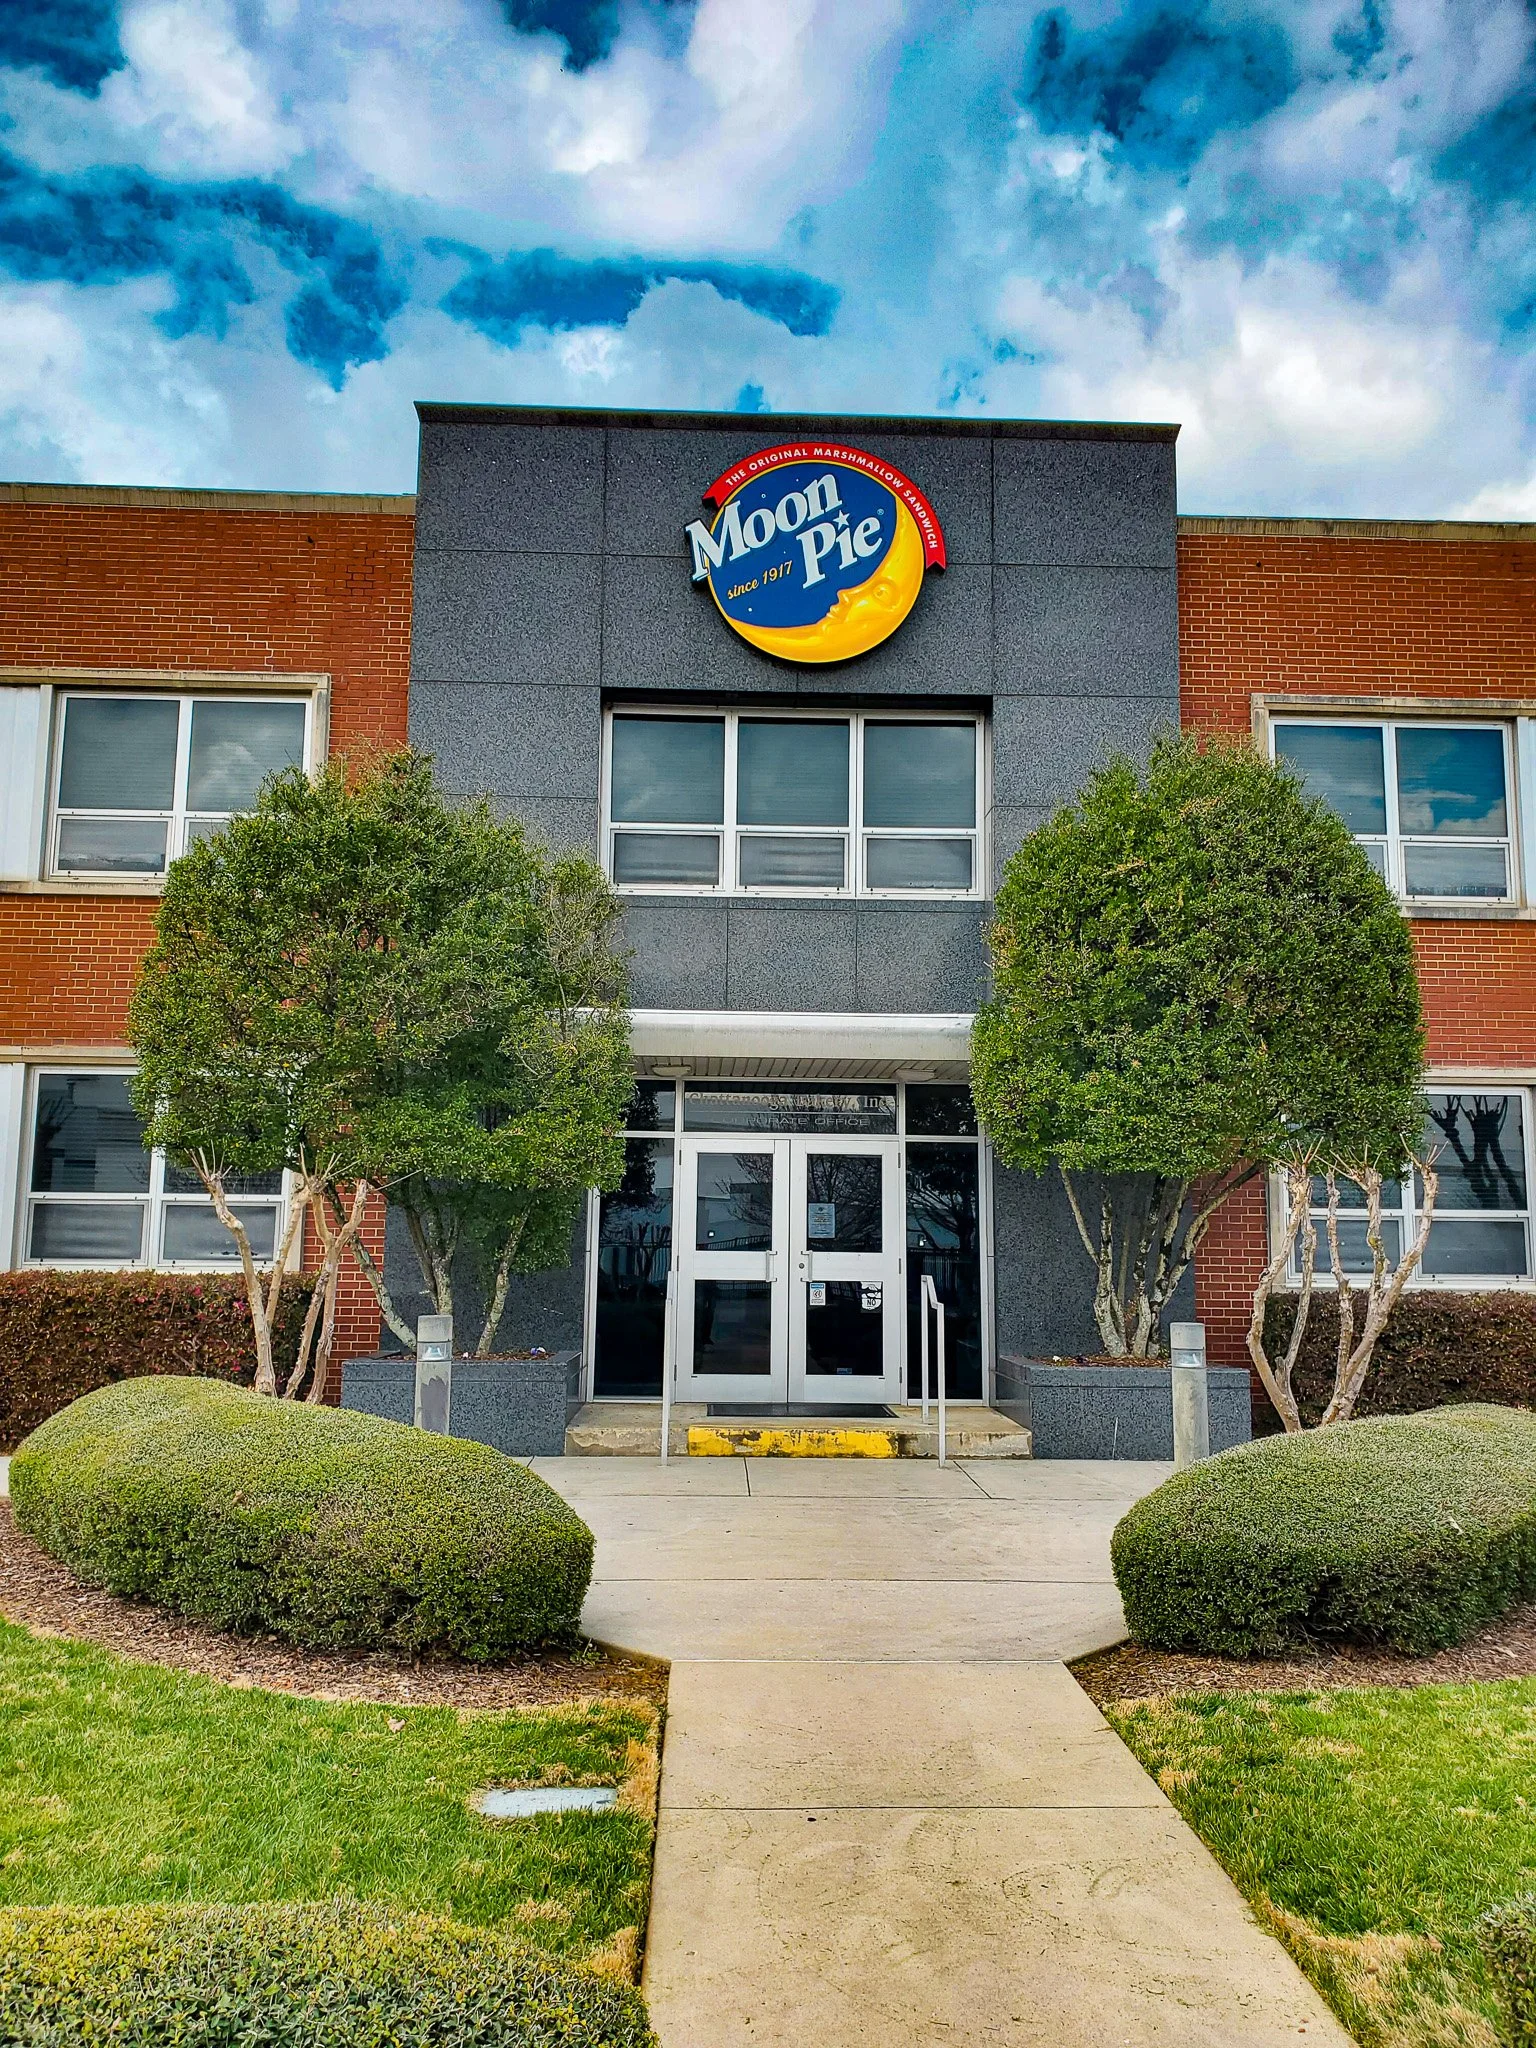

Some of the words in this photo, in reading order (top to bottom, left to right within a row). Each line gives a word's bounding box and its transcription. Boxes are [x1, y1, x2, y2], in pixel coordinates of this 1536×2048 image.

[686, 474, 843, 581] Moon
[725, 469, 746, 486] THE
[749, 448, 808, 471] ORIGINAL
[814, 448, 904, 488] MARSHMALLOW
[903, 490, 938, 549] SANDWICH
[796, 511, 883, 589] Pie
[727, 578, 759, 600] since
[762, 560, 793, 585] 1917
[689, 1093, 787, 1111] Chattanooga
[814, 1117, 870, 1126] OFFICE
